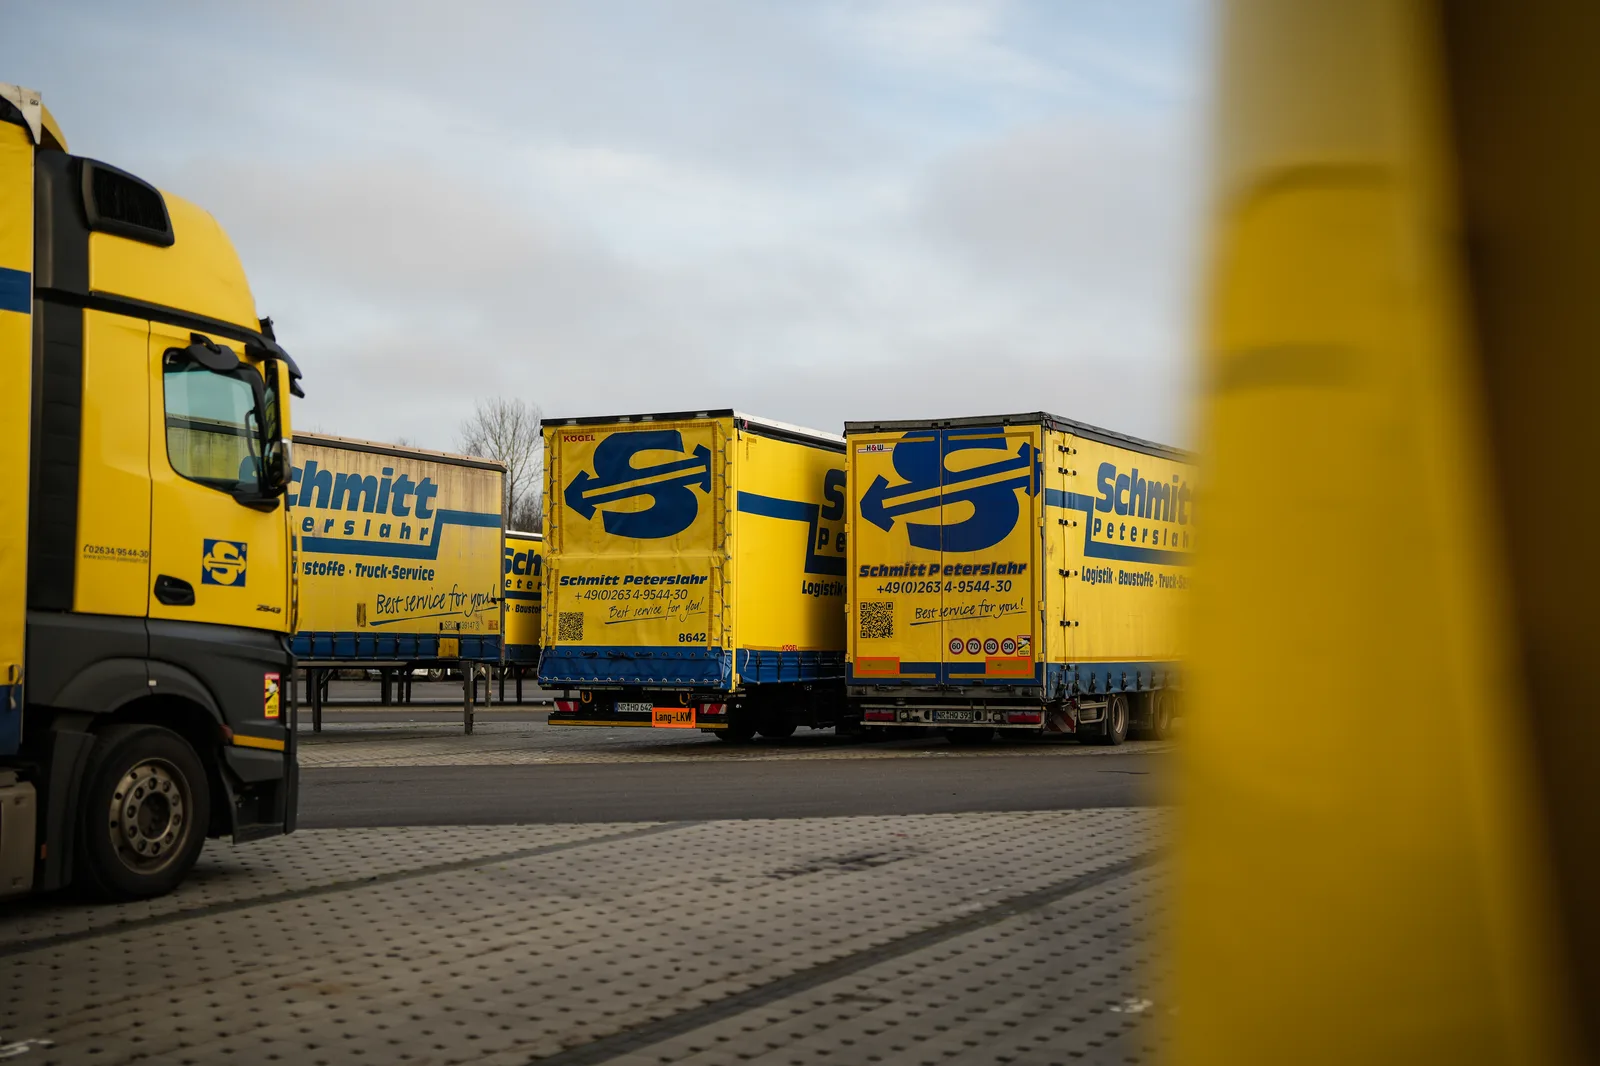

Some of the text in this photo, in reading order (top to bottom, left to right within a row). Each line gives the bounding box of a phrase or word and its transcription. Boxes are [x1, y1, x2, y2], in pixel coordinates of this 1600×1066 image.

[563, 433, 596, 442] KÖGEL
[866, 443, 884, 452] H&W
[301, 516, 429, 541] erslahr
[293, 561, 435, 582] stoffe Truck-Service
[858, 561, 1027, 577] Schmitt Peterslahr
[1081, 565, 1113, 585] Logistik
[1118, 569, 1154, 587] Baustoffe
[559, 574, 708, 586] Schmitt Peterslahr
[801, 579, 844, 598] Logistik
[376, 583, 497, 617] Best service for you!
[915, 597, 1025, 619] Best service for you!
[608, 597, 704, 622] Best service for you!
[678, 632, 707, 643] 8642
[951, 642, 1013, 650] 60 70 80 90
[655, 711, 692, 724] Lang-LKW
